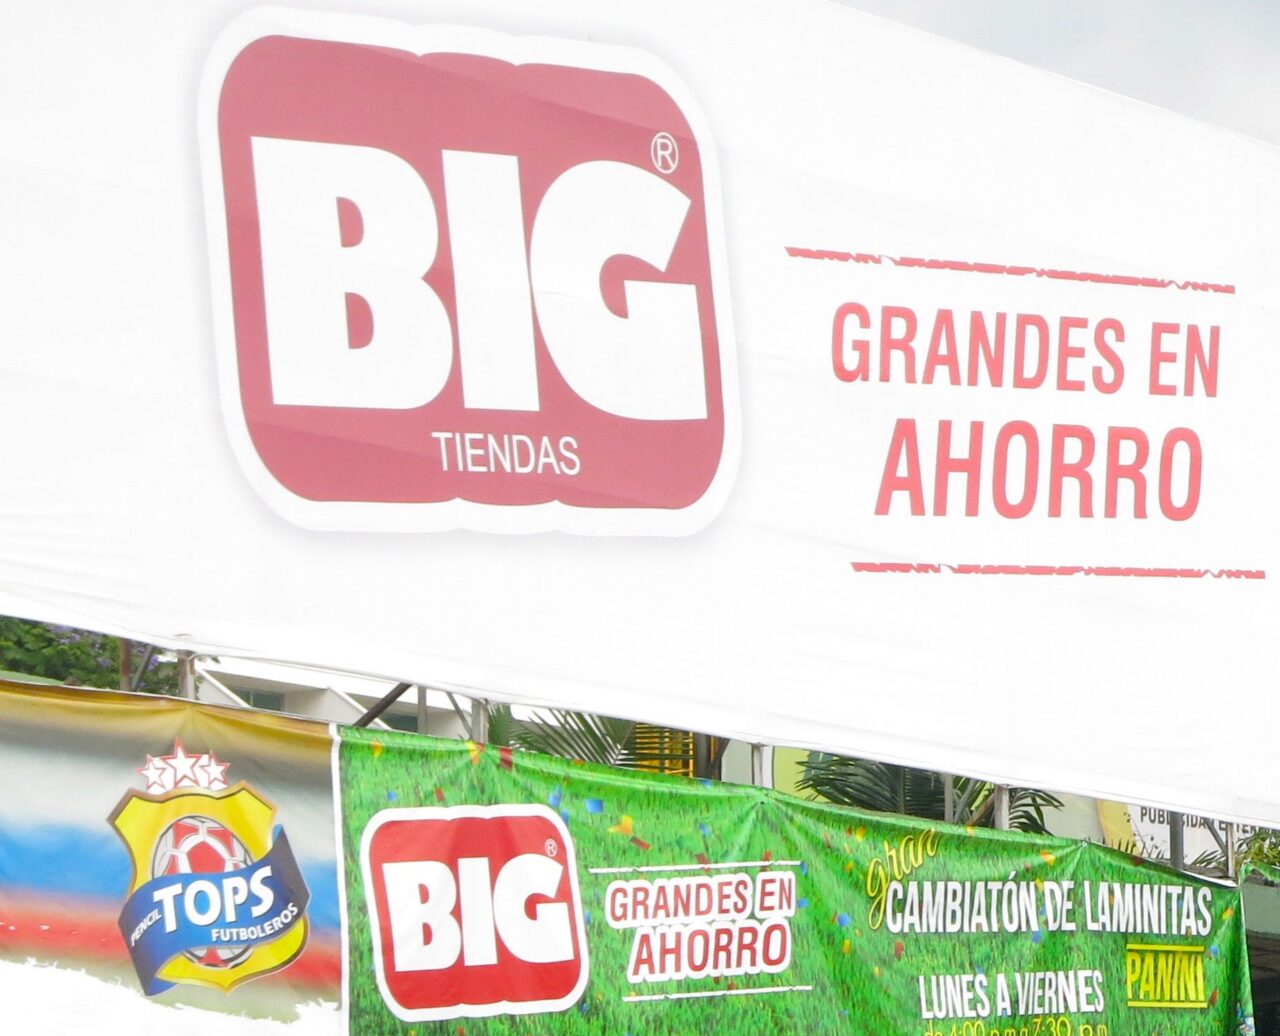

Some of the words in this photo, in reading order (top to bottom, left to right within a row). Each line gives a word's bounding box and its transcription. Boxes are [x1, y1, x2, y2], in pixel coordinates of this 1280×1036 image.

[250, 136, 708, 421] BIG
[830, 302, 1126, 395] GRANDES
[1148, 321, 1221, 398] EN
[431, 431, 581, 476] TIENDAS
[873, 418, 1202, 522] AHORRO
[153, 865, 274, 933] TOPS
[610, 879, 748, 922] GRANDES
[759, 877, 792, 912] EN
[866, 827, 940, 930] gran
[885, 871, 1040, 933] CAMBIATÓN
[1044, 880, 1076, 931] DE
[1084, 880, 1213, 937] LAMINITAS
[130, 908, 162, 947] PENCIL
[211, 902, 299, 942] FUTBOLEROS
[382, 853, 575, 972] BIG
[632, 923, 787, 977] AHORRO
[1126, 951, 1206, 1001] PANINI
[919, 973, 991, 1019] LUNES
[996, 973, 1012, 1017] A
[1015, 969, 1105, 1015] VIERNES
